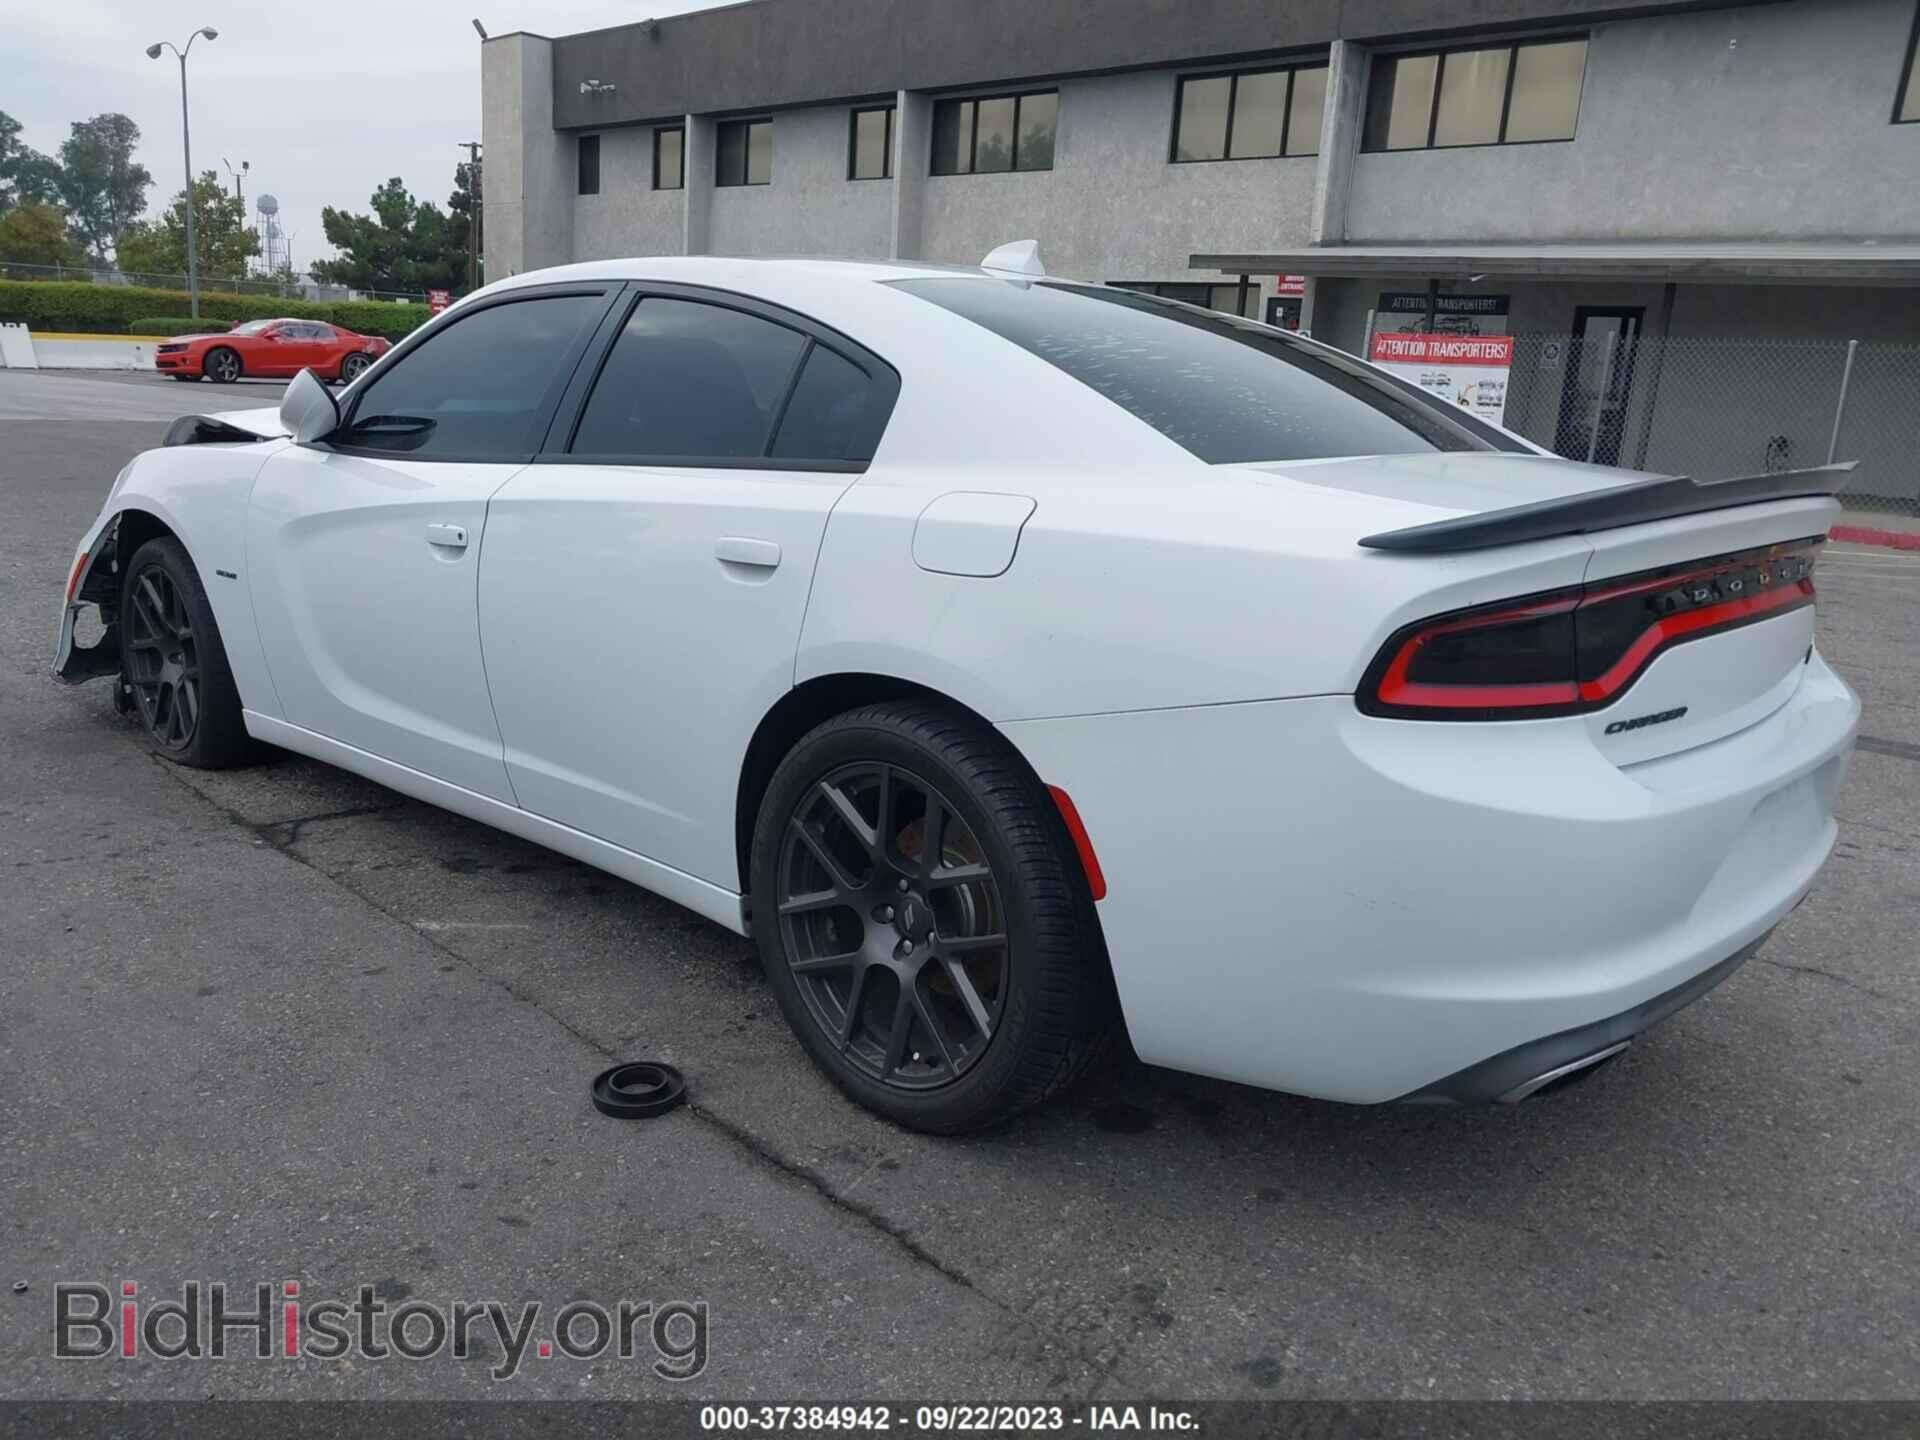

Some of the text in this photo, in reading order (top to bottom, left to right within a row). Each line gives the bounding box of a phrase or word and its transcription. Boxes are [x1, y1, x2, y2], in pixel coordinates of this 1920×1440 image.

[1391, 297, 1426, 309] ATTENTI
[1376, 339, 1509, 359] ATTENTION TRANSPORTERS!
[1604, 706, 1689, 735] CHARGER
